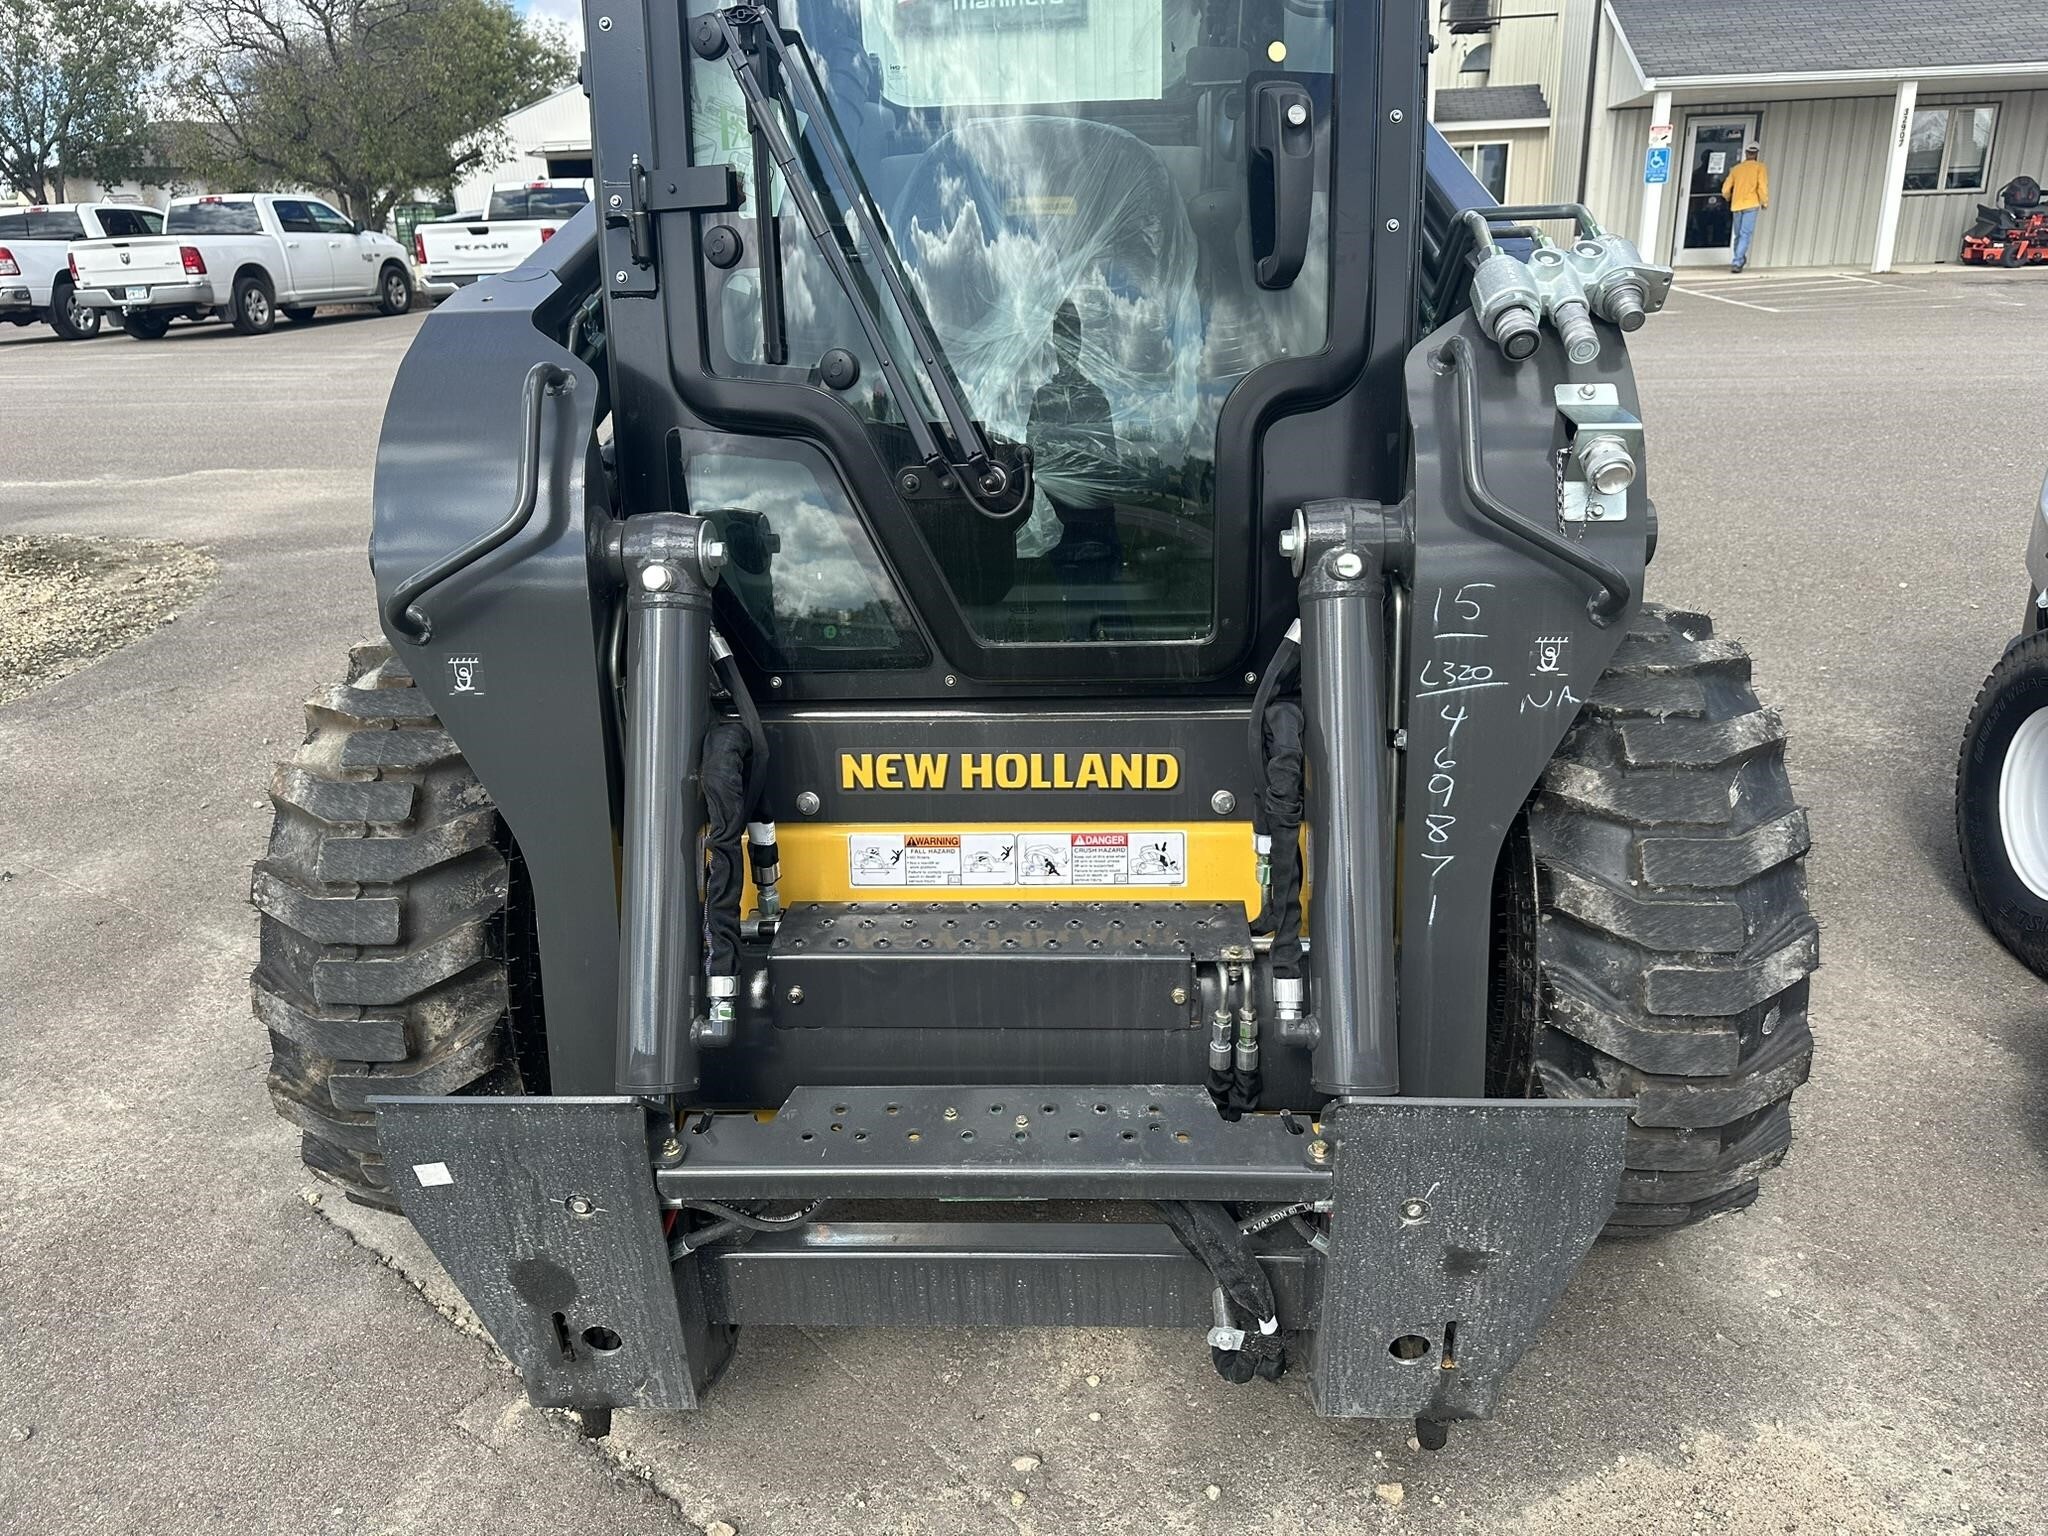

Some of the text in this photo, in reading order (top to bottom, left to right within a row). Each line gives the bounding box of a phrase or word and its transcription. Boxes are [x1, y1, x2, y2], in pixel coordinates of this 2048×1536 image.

[1433, 583, 1496, 623] 15
[840, 752, 1180, 790] NEW HOLLAND
[915, 836, 959, 846] WARNING
[1085, 835, 1125, 845] DANGER
